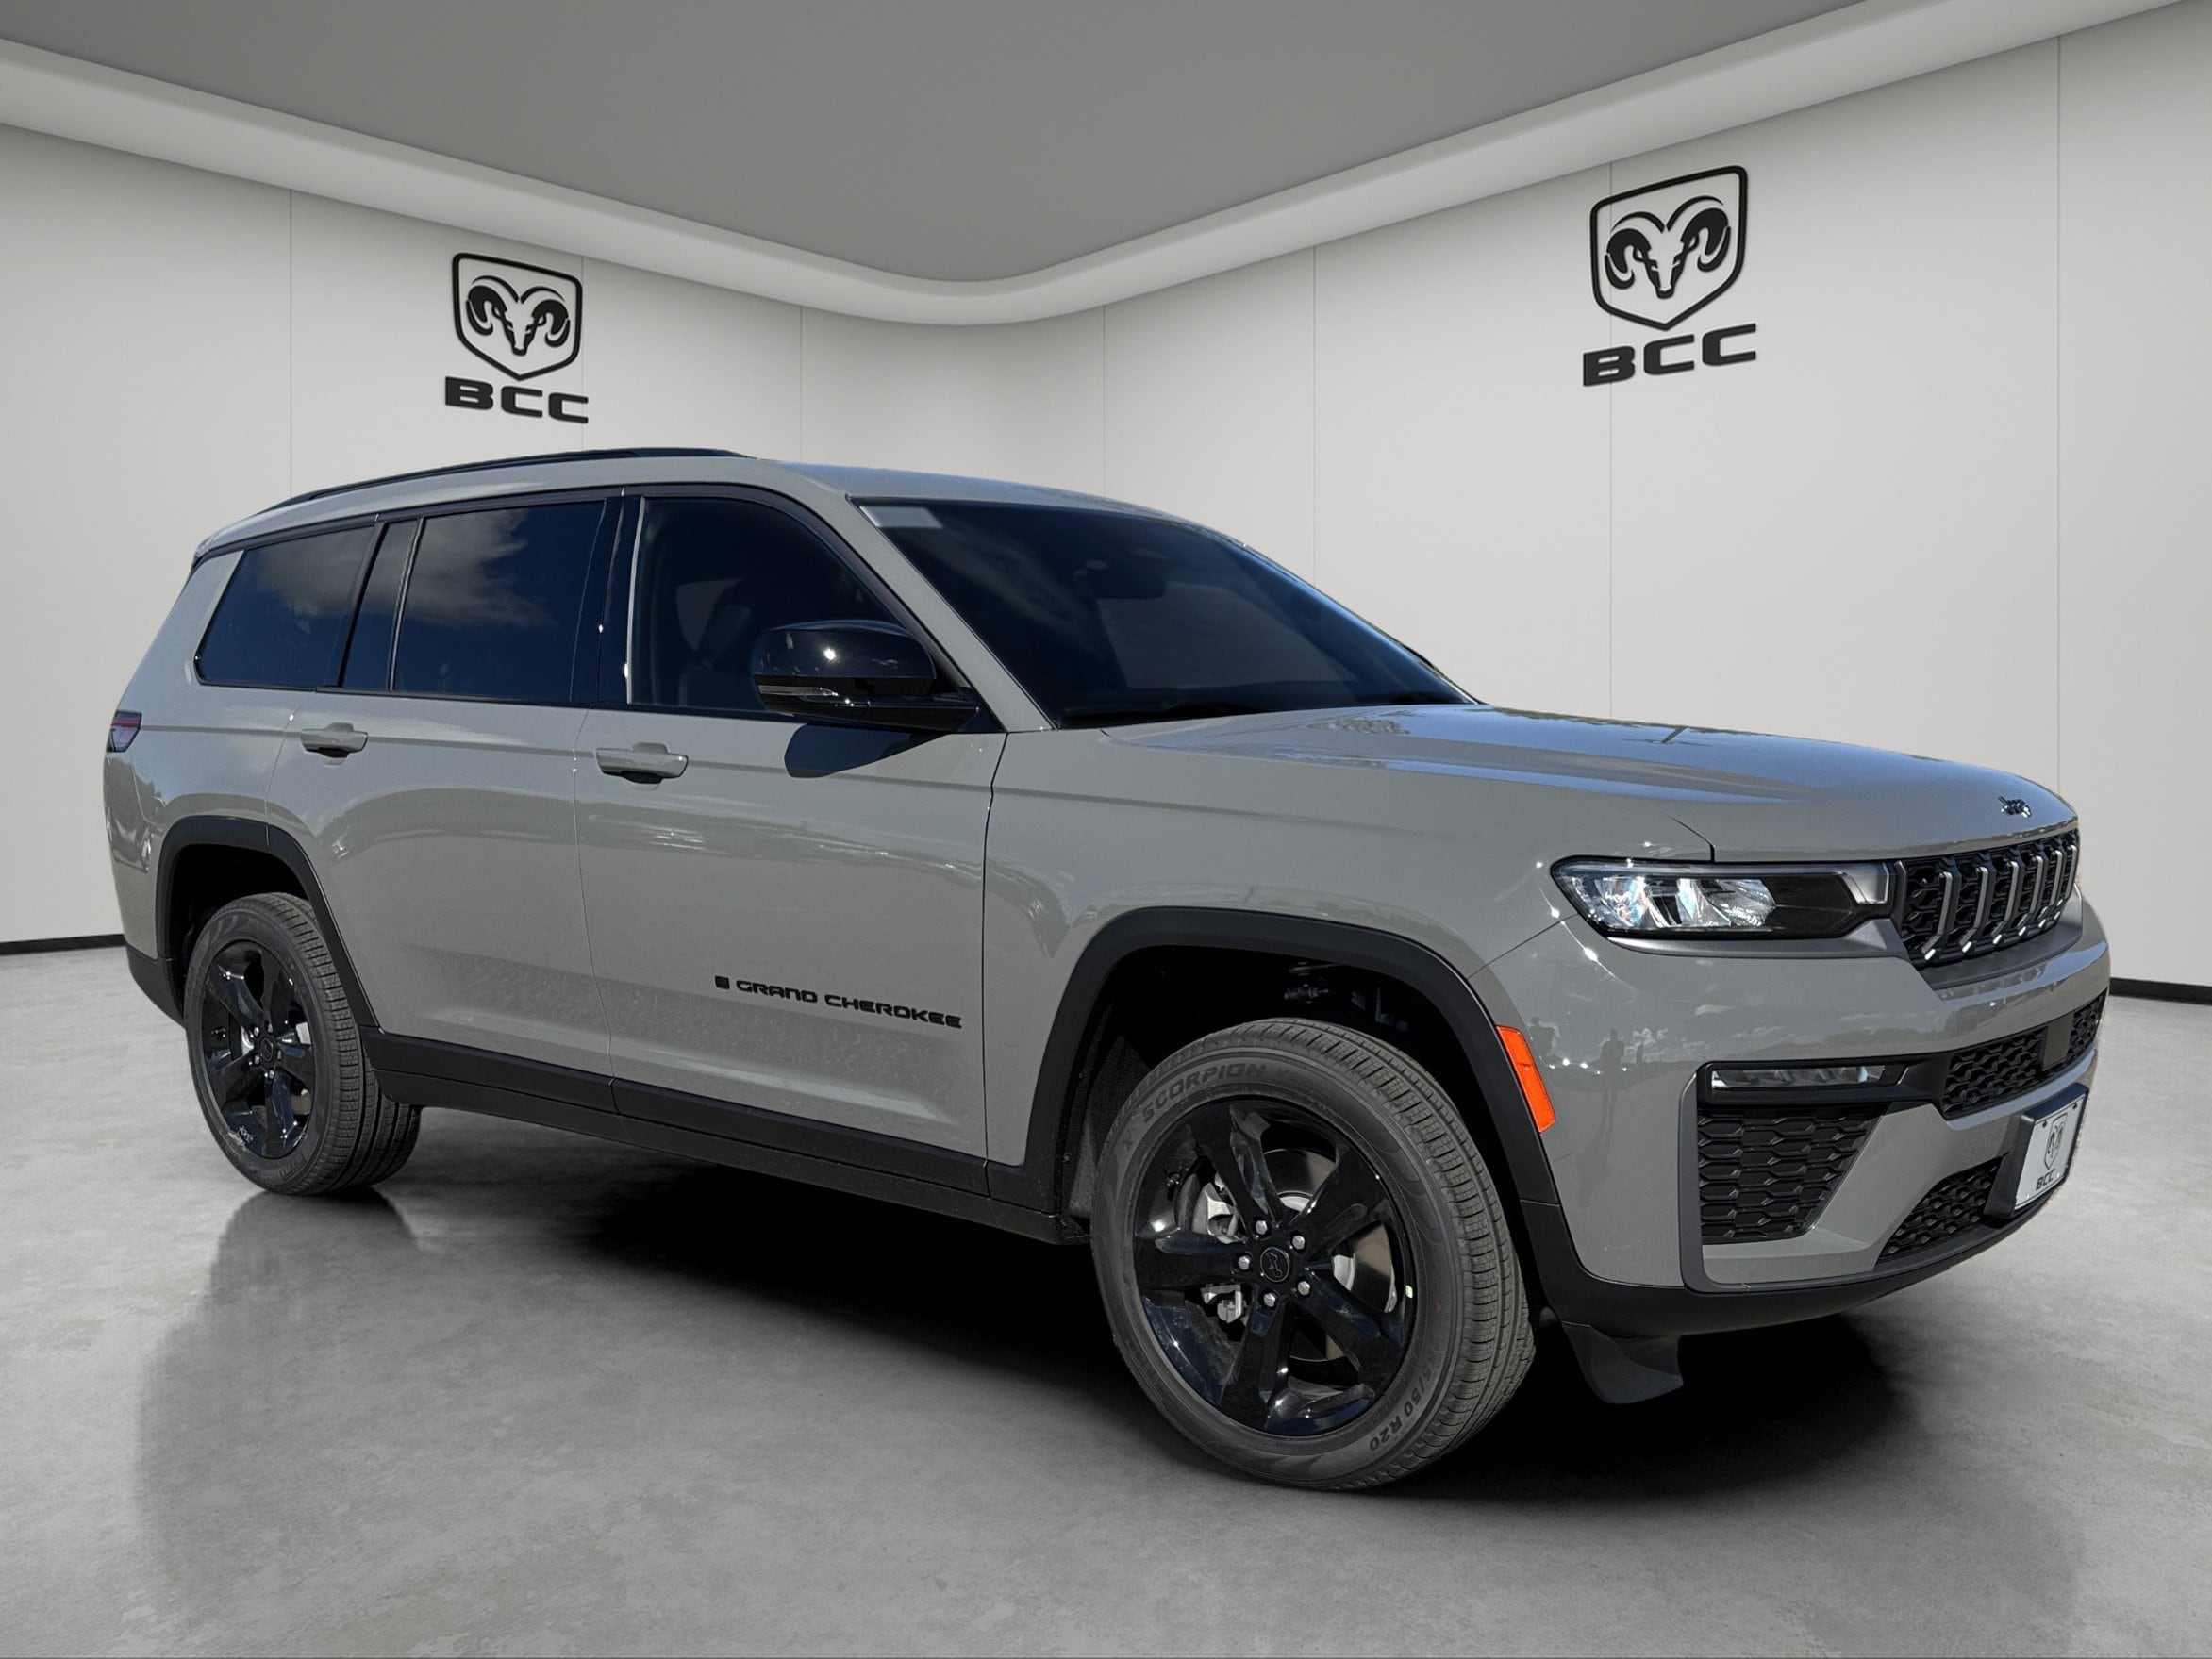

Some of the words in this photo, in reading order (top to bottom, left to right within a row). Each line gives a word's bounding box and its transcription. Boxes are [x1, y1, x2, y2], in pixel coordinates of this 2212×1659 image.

[1582, 323, 1757, 387] BCC
[444, 375, 589, 424] BCC
[735, 980, 819, 1004] GRAND
[823, 994, 962, 1029] CHEROKEE
[1141, 1062, 1268, 1123] SCORPION
[2035, 1168, 2056, 1191] BCC
[1369, 1415, 1403, 1452] R20
